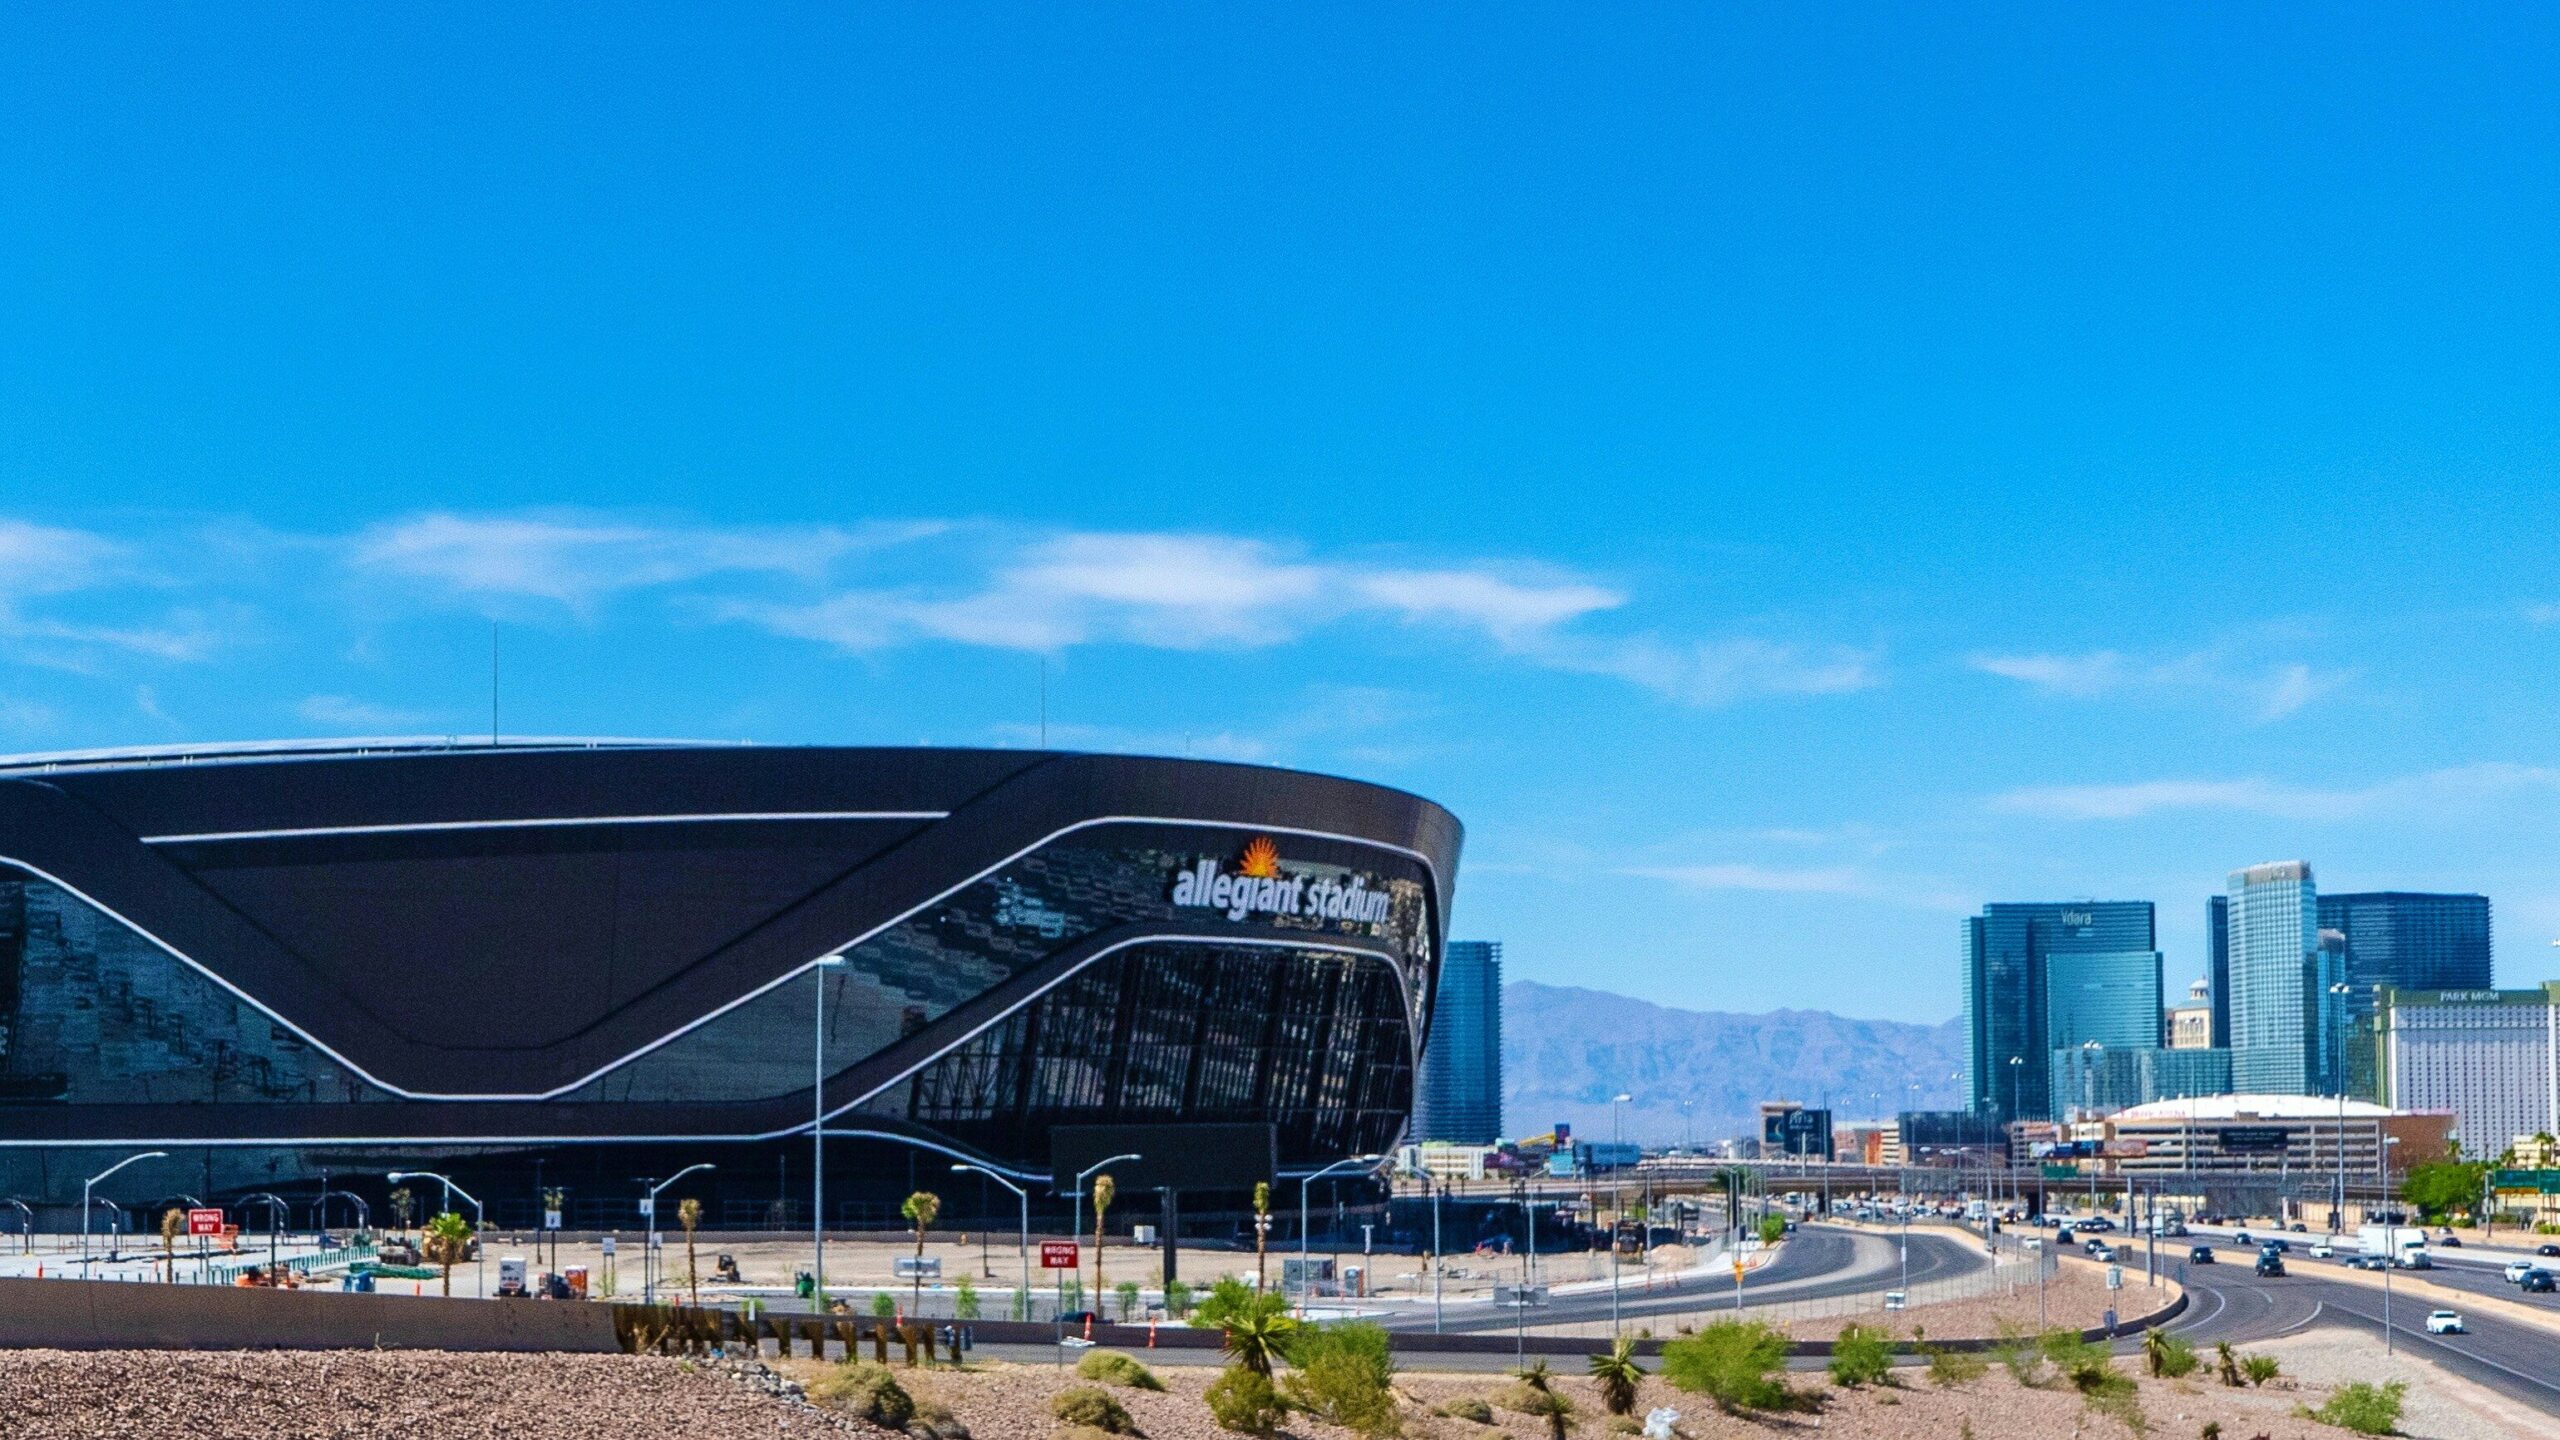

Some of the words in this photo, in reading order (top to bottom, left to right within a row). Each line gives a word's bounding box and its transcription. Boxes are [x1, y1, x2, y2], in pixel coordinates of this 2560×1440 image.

[1173, 859, 1303, 922] allegiant
[1304, 875, 1391, 924] stadium
[2060, 909, 2092, 926] Vdara
[2440, 991, 2468, 1002] PARK
[2471, 991, 2499, 1002] MGM
[193, 1213, 219, 1222] WRONG
[197, 1223, 213, 1231] WAY
[1044, 1245, 1075, 1255] WRONG
[1050, 1256, 1069, 1265] WAY
